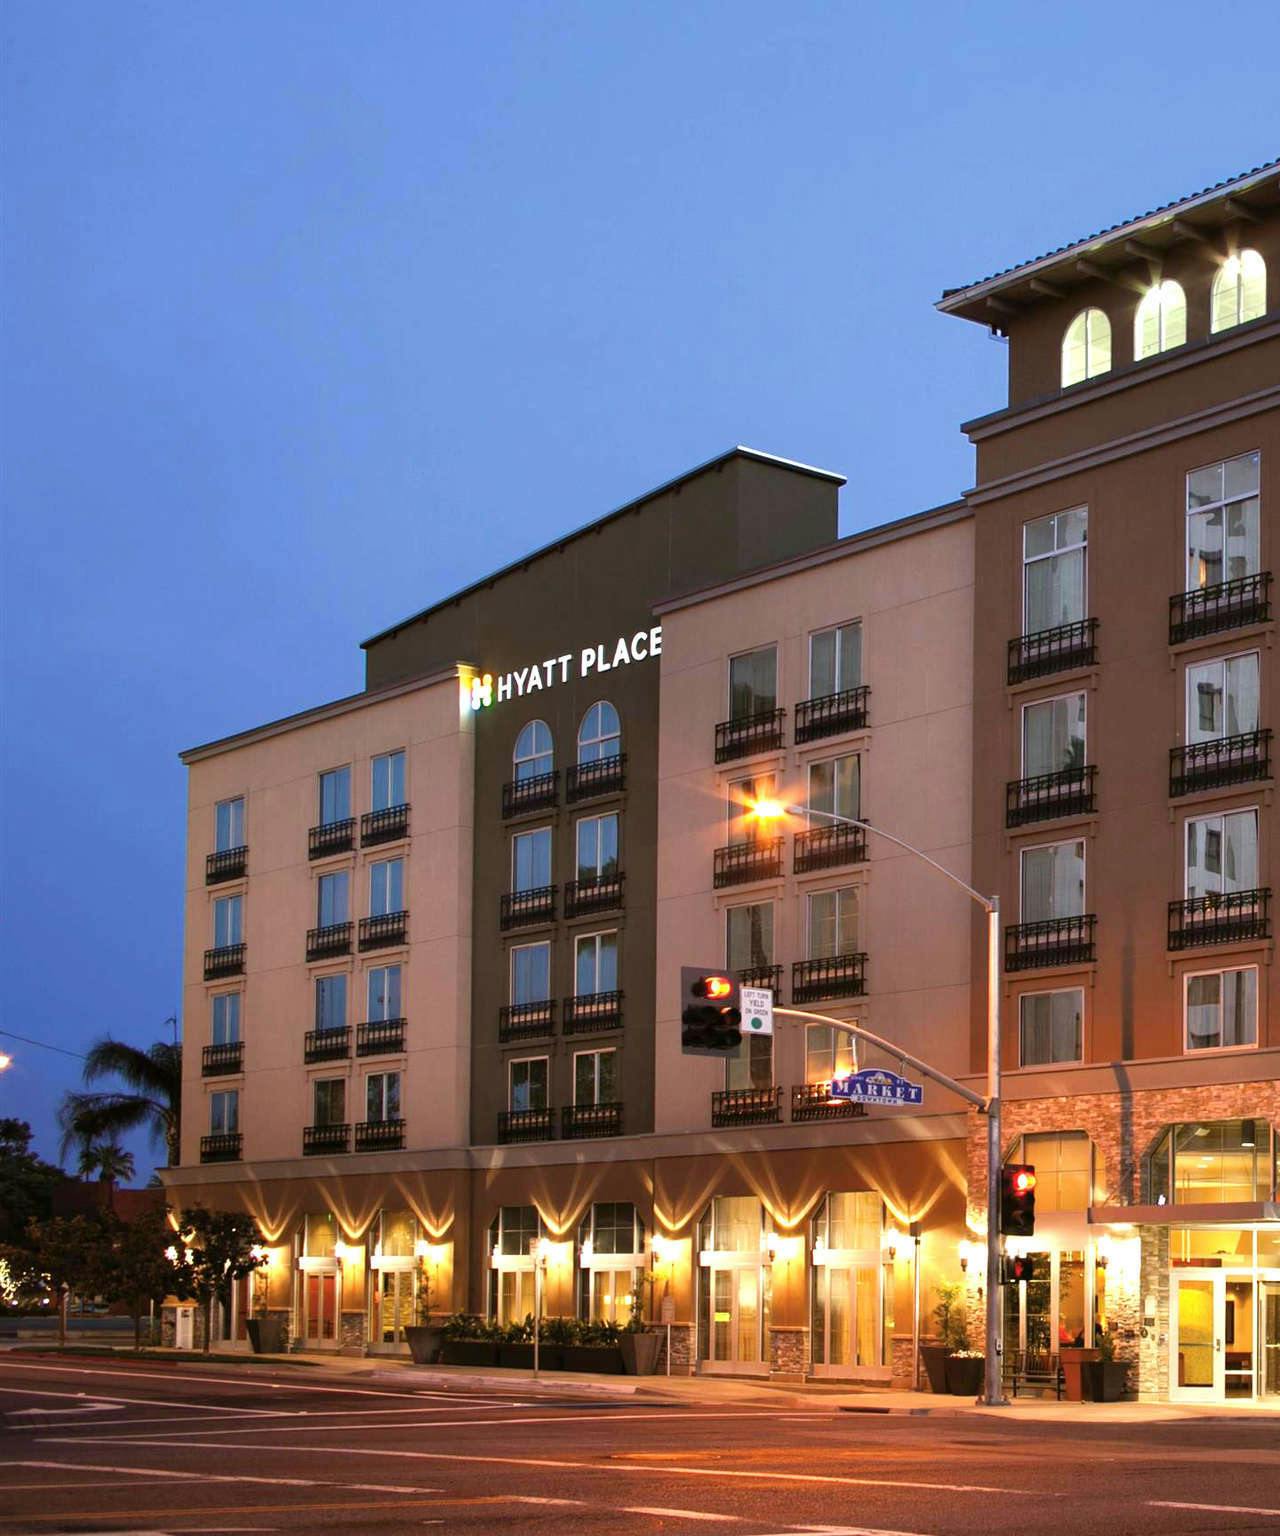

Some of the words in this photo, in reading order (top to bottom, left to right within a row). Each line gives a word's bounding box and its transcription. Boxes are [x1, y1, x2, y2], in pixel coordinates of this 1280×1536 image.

[497, 654, 572, 703] HYATT
[580, 626, 663, 678] PLACE
[836, 1081, 918, 1100] MARKET
[856, 1094, 898, 1104] DOWNTOWN
